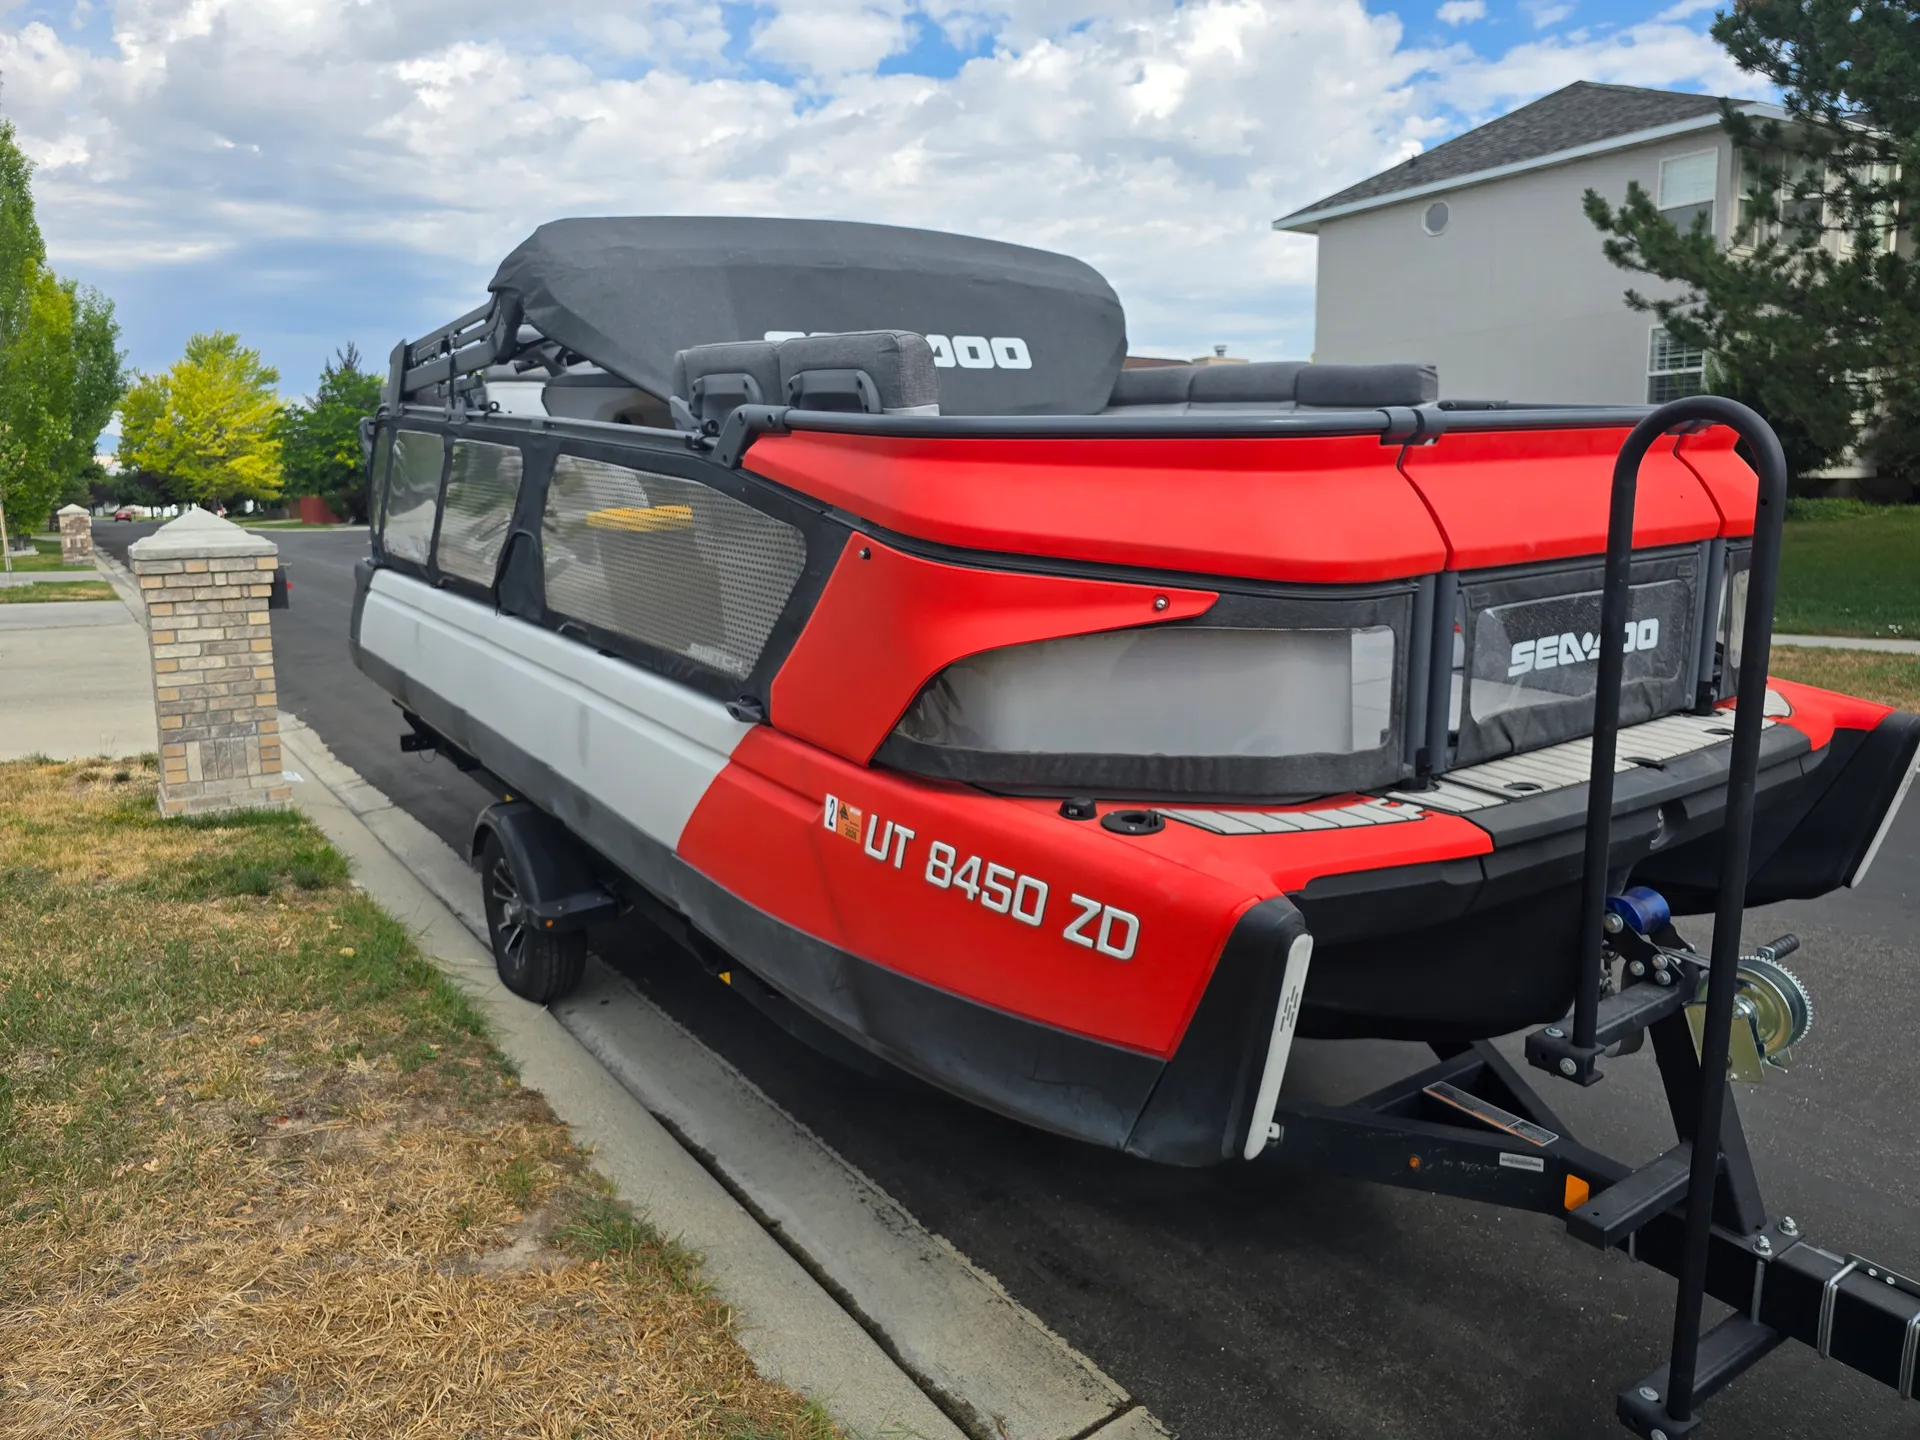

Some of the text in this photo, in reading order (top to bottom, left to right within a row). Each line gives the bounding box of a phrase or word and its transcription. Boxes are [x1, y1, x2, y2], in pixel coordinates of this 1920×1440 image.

[864, 813, 1141, 960] UT 8450 ZD
